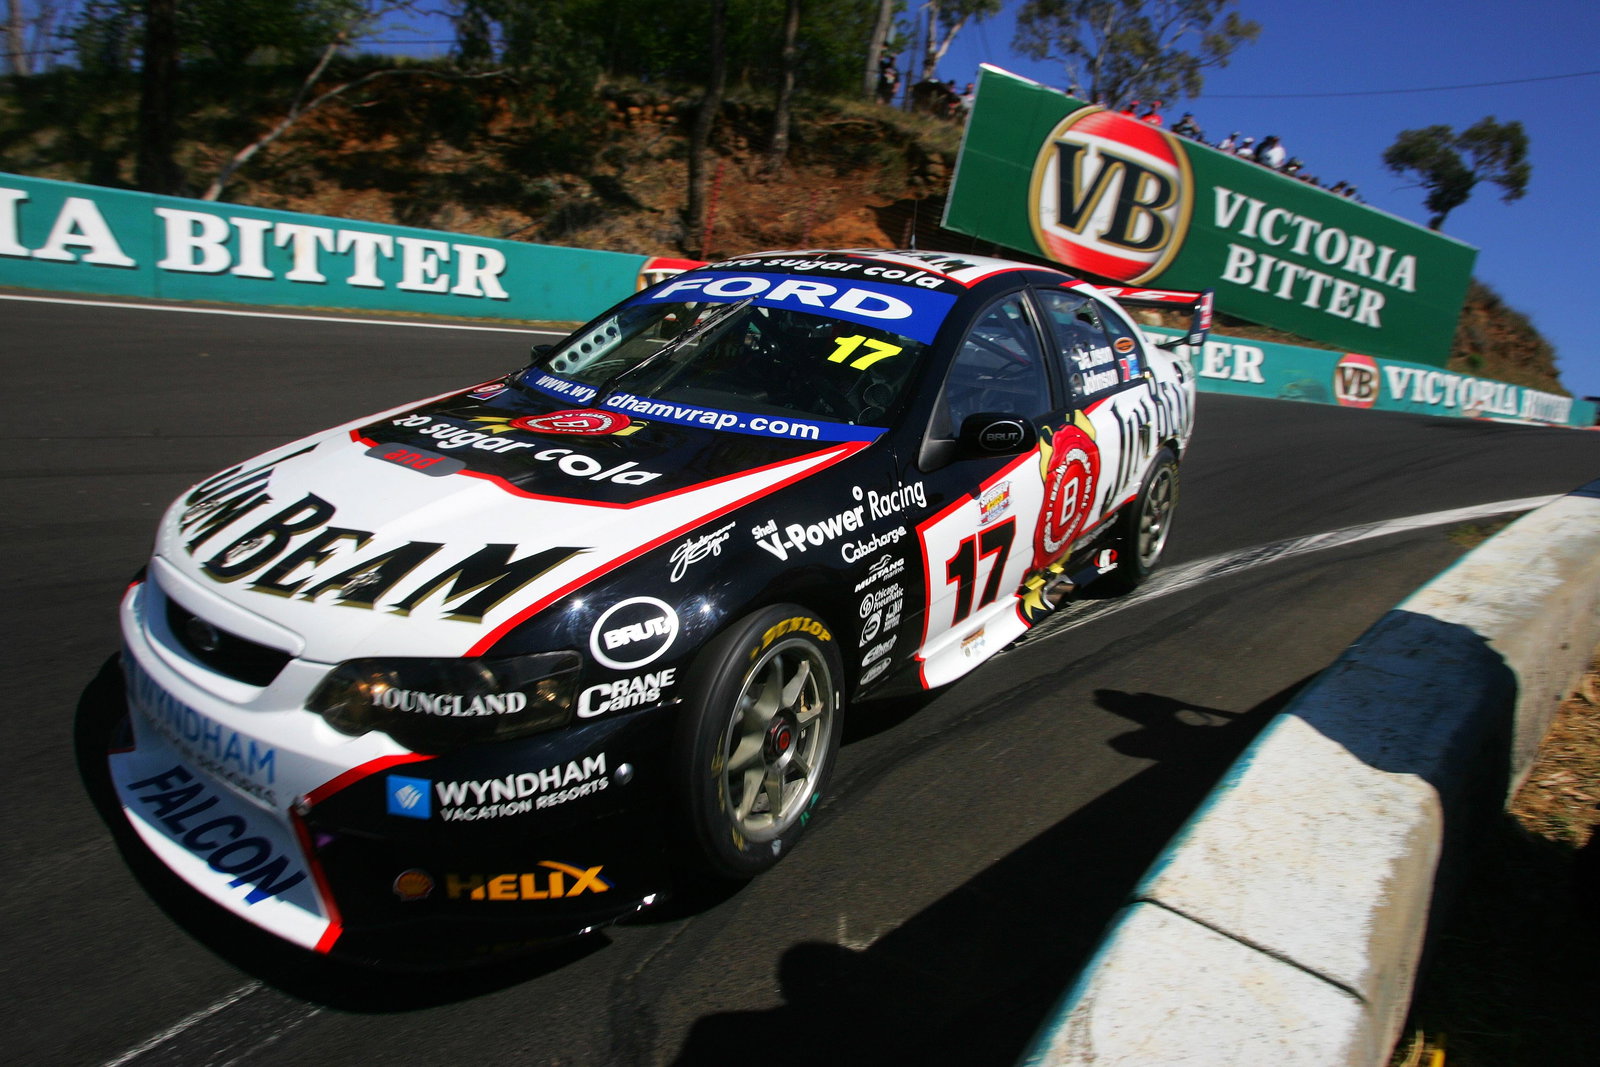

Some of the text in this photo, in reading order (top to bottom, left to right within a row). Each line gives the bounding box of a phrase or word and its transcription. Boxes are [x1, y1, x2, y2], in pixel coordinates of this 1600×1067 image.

[1053, 139, 1180, 253] VB
[154, 205, 511, 301] BITTER
[1213, 185, 1417, 293] VICTORIA
[764, 256, 861, 271] sugar
[863, 264, 945, 290] cola
[1220, 243, 1386, 329] BITTER
[651, 276, 913, 320] FORD
[826, 335, 902, 371] 17
[535, 373, 820, 441] www.wydhamvrap.com
[1336, 367, 1376, 399] VB
[1384, 364, 1518, 416] VICTORIA
[383, 448, 447, 470] and
[418, 423, 536, 453] sugar
[534, 448, 663, 486] cola
[986, 432, 1019, 443] BRUT
[751, 519, 778, 540] Shell
[756, 504, 865, 562] V-Power
[868, 480, 928, 521] Racing
[199, 490, 597, 624] BEAM
[841, 526, 907, 564] Cabcharge
[854, 557, 905, 593] MUSTANG
[874, 582, 899, 602] Chicago
[945, 514, 1016, 629] 17
[872, 587, 904, 612] Pneumatic
[604, 616, 668, 650] BRUT
[761, 616, 832, 651] DUNLOP
[371, 686, 528, 718] YOUNGLAND
[577, 667, 678, 718] CRANE
[435, 752, 607, 807] WYNDHAM
[440, 777, 609, 822] VACATION RESORTS
[127, 764, 307, 906] FALCON
[446, 860, 614, 901] HELIX
